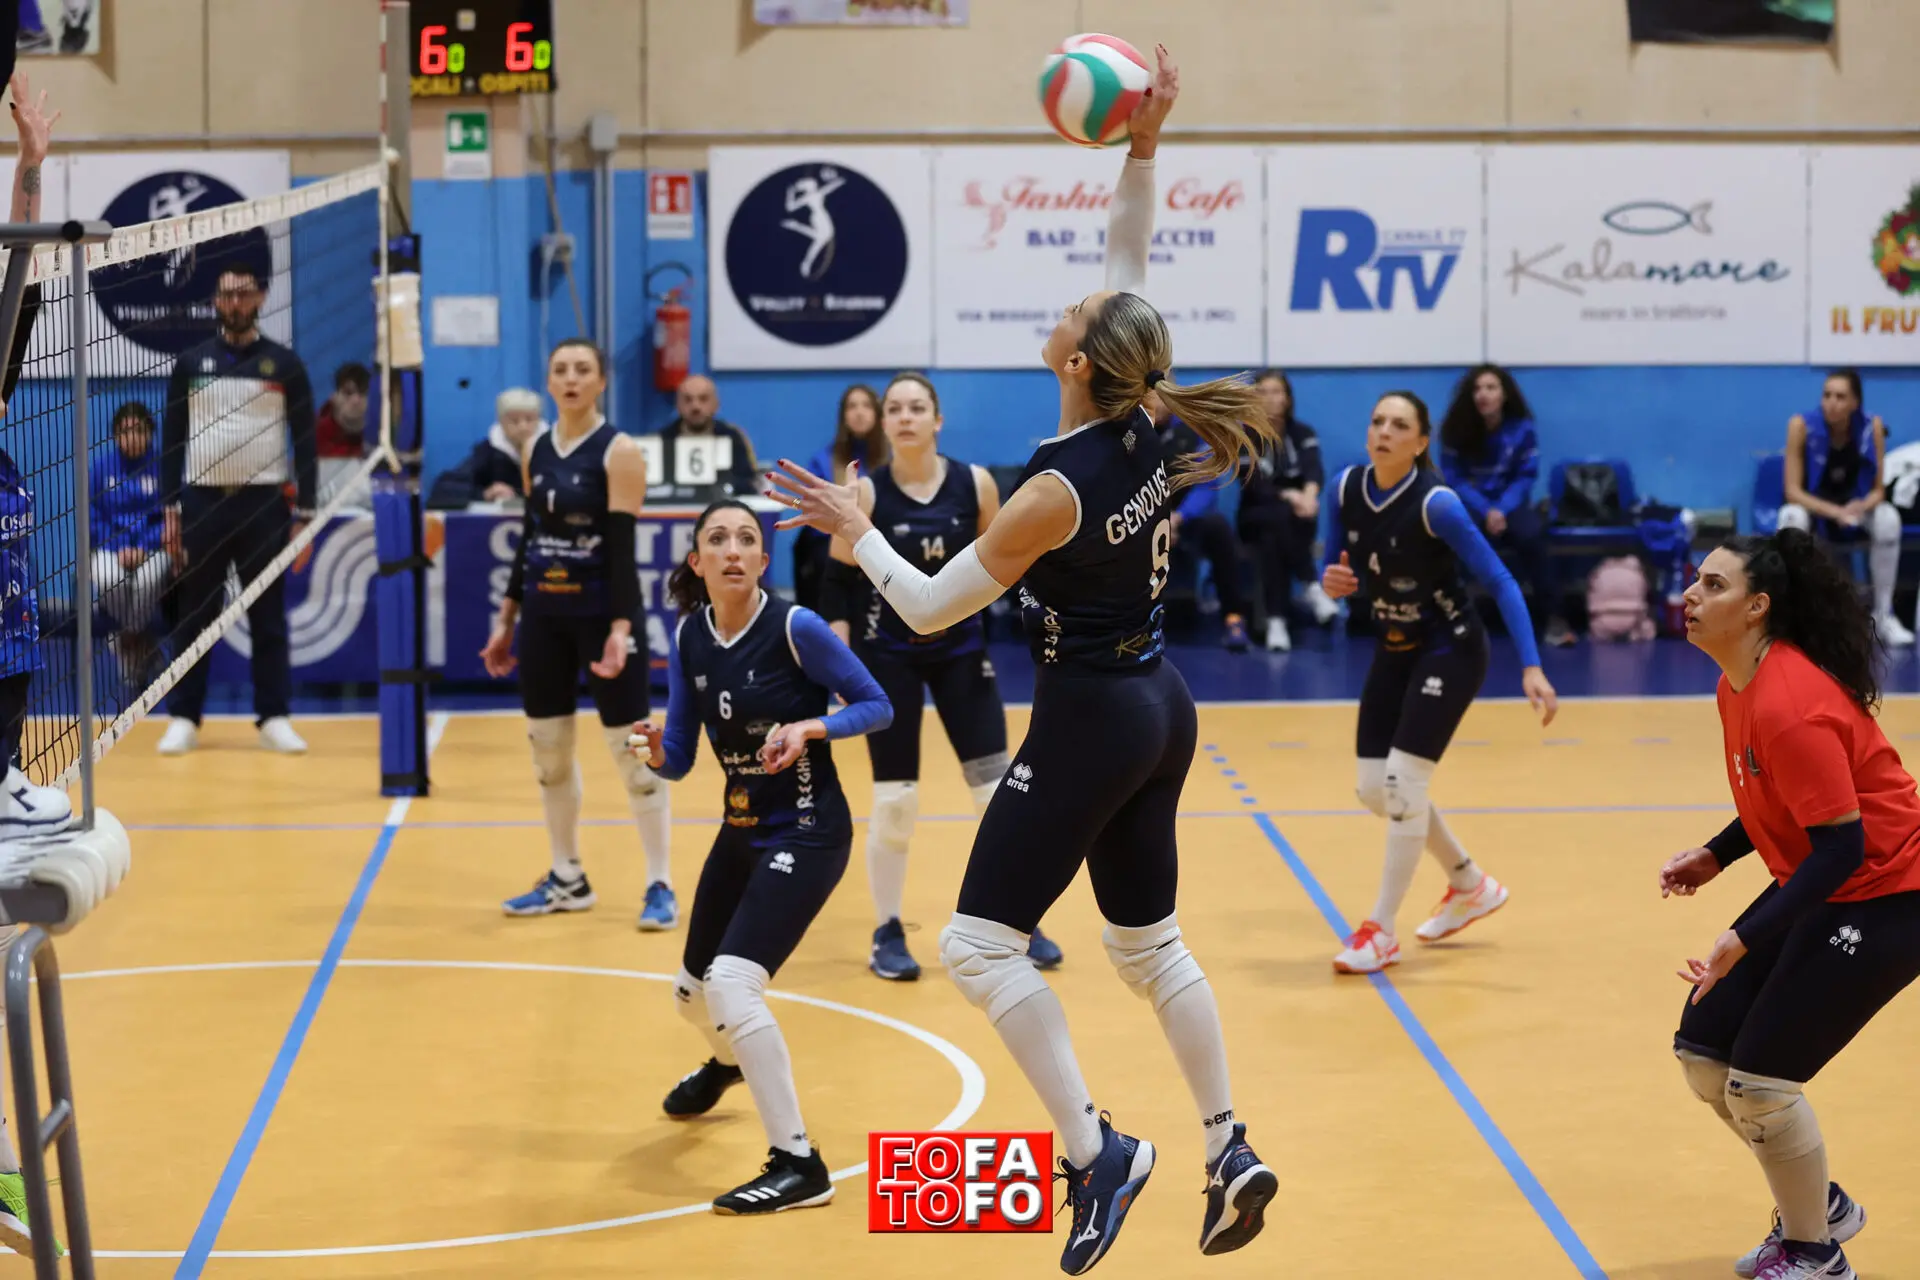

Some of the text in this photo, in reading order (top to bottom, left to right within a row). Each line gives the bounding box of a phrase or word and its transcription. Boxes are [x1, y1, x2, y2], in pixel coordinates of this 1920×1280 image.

[420, 25, 465, 74] 6 0
[505, 22, 551, 71] 6 0
[410, 75, 460, 95] OCALI
[1027, 230, 1075, 247] BAR
[1504, 238, 1790, 295] Kalamare
[1831, 306, 1852, 333] IL
[689, 448, 704, 478] 6
[547, 489, 556, 513] 1
[1105, 457, 1171, 545] GENOVE
[920, 536, 945, 562] 14
[1368, 552, 1381, 575] 4
[719, 690, 732, 719] 6
[1006, 777, 1030, 793] errea
